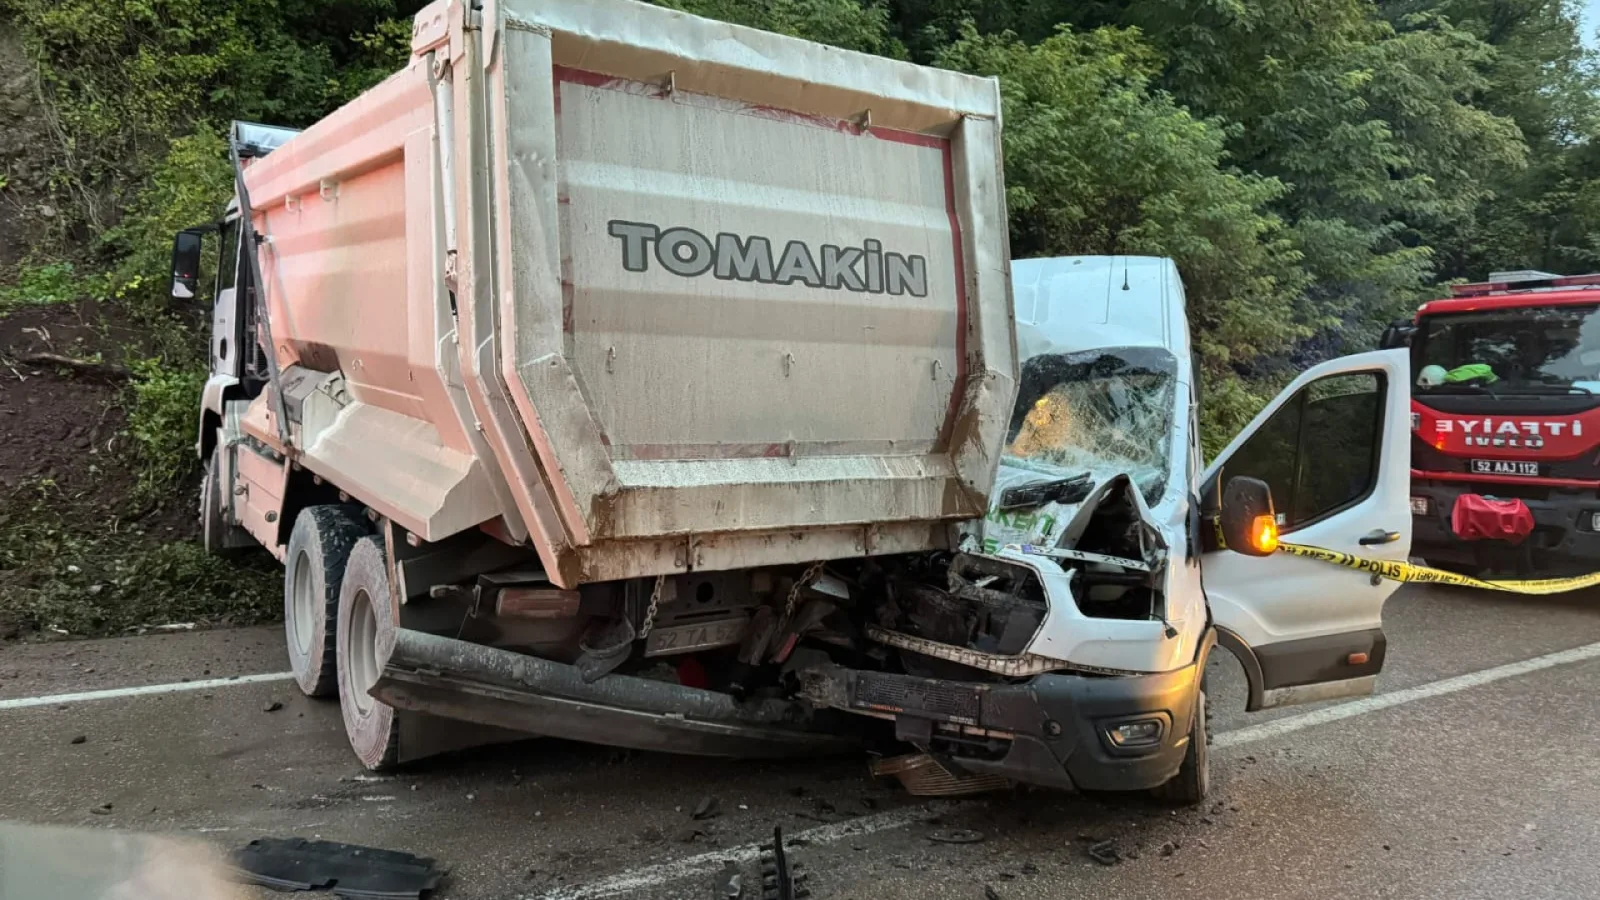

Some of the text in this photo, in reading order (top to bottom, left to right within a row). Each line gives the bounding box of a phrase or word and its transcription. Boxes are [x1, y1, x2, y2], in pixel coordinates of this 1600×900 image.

[1477, 461, 1537, 474] 52 AAJ 112
[1358, 558, 1401, 578] POLİS
